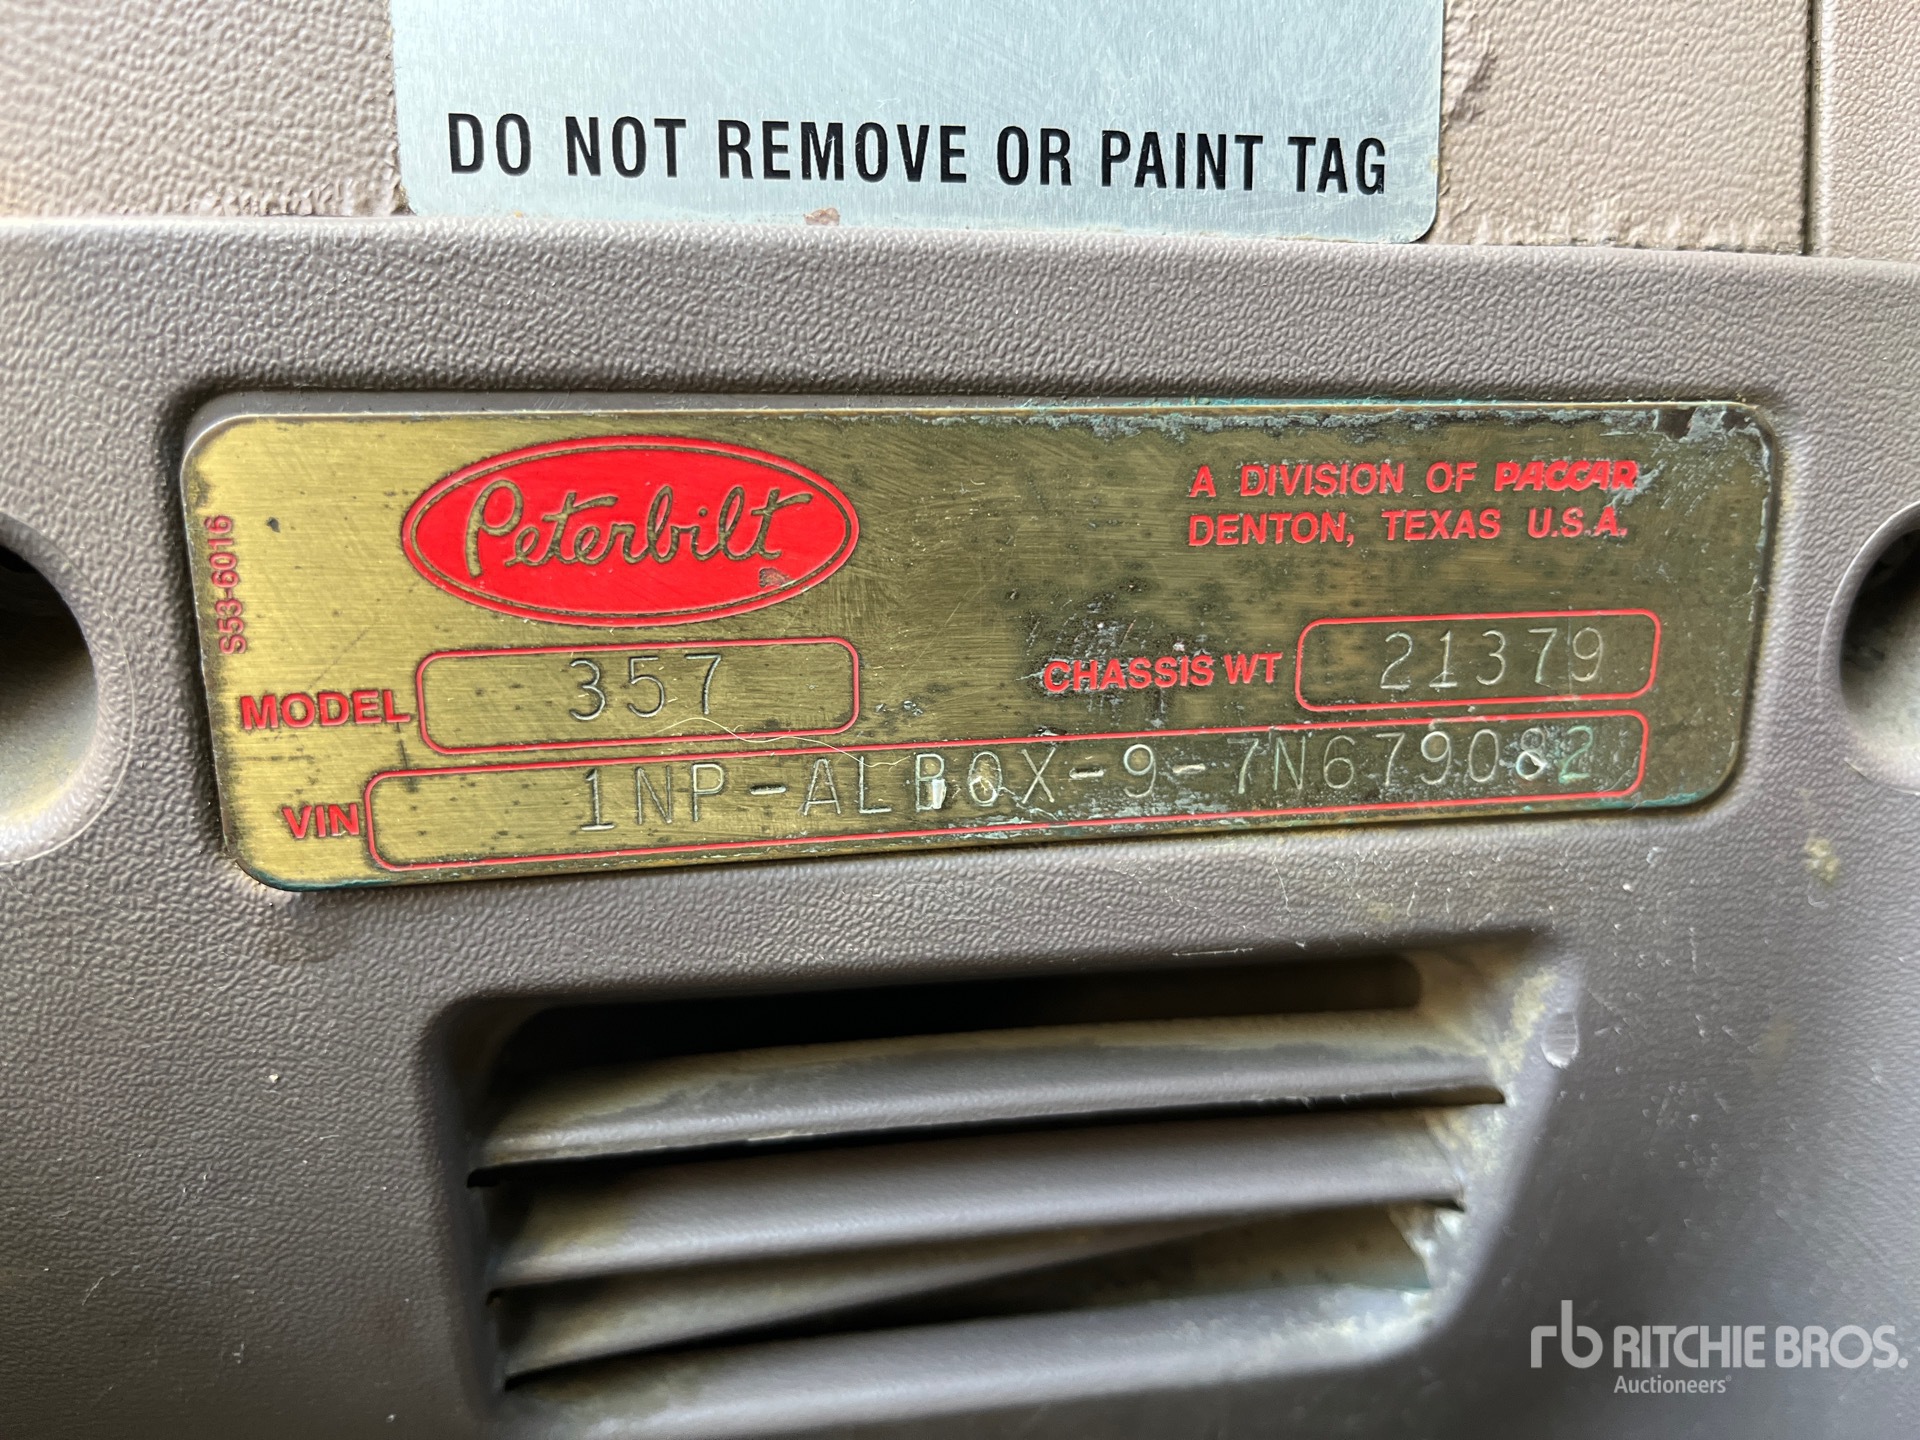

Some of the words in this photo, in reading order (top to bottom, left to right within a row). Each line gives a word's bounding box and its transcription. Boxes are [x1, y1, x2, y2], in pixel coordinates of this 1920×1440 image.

[448, 112, 531, 175] DO
[565, 116, 686, 177] NOT
[718, 119, 967, 183] REMOVE
[996, 125, 1072, 186] OR
[1101, 130, 1264, 191] PAINT
[1287, 136, 1386, 196] TAG
[1189, 464, 1217, 497] A
[1239, 461, 1406, 496] DIVISION
[1425, 460, 1478, 494] OF
[1494, 459, 1639, 493] PACCAR
[463, 479, 814, 578] Peterbilt
[1188, 510, 1355, 547] DENTON,
[1382, 507, 1503, 541] TEXAS
[1527, 506, 1629, 538] U.S.A.
[204, 514, 247, 655] S53-6016
[240, 689, 411, 729] MODEL
[568, 653, 724, 722] 357
[1043, 653, 1215, 692] CHASSIS
[1223, 651, 1283, 684] WT
[1379, 625, 1604, 691] 21379
[282, 803, 361, 838] VIN
